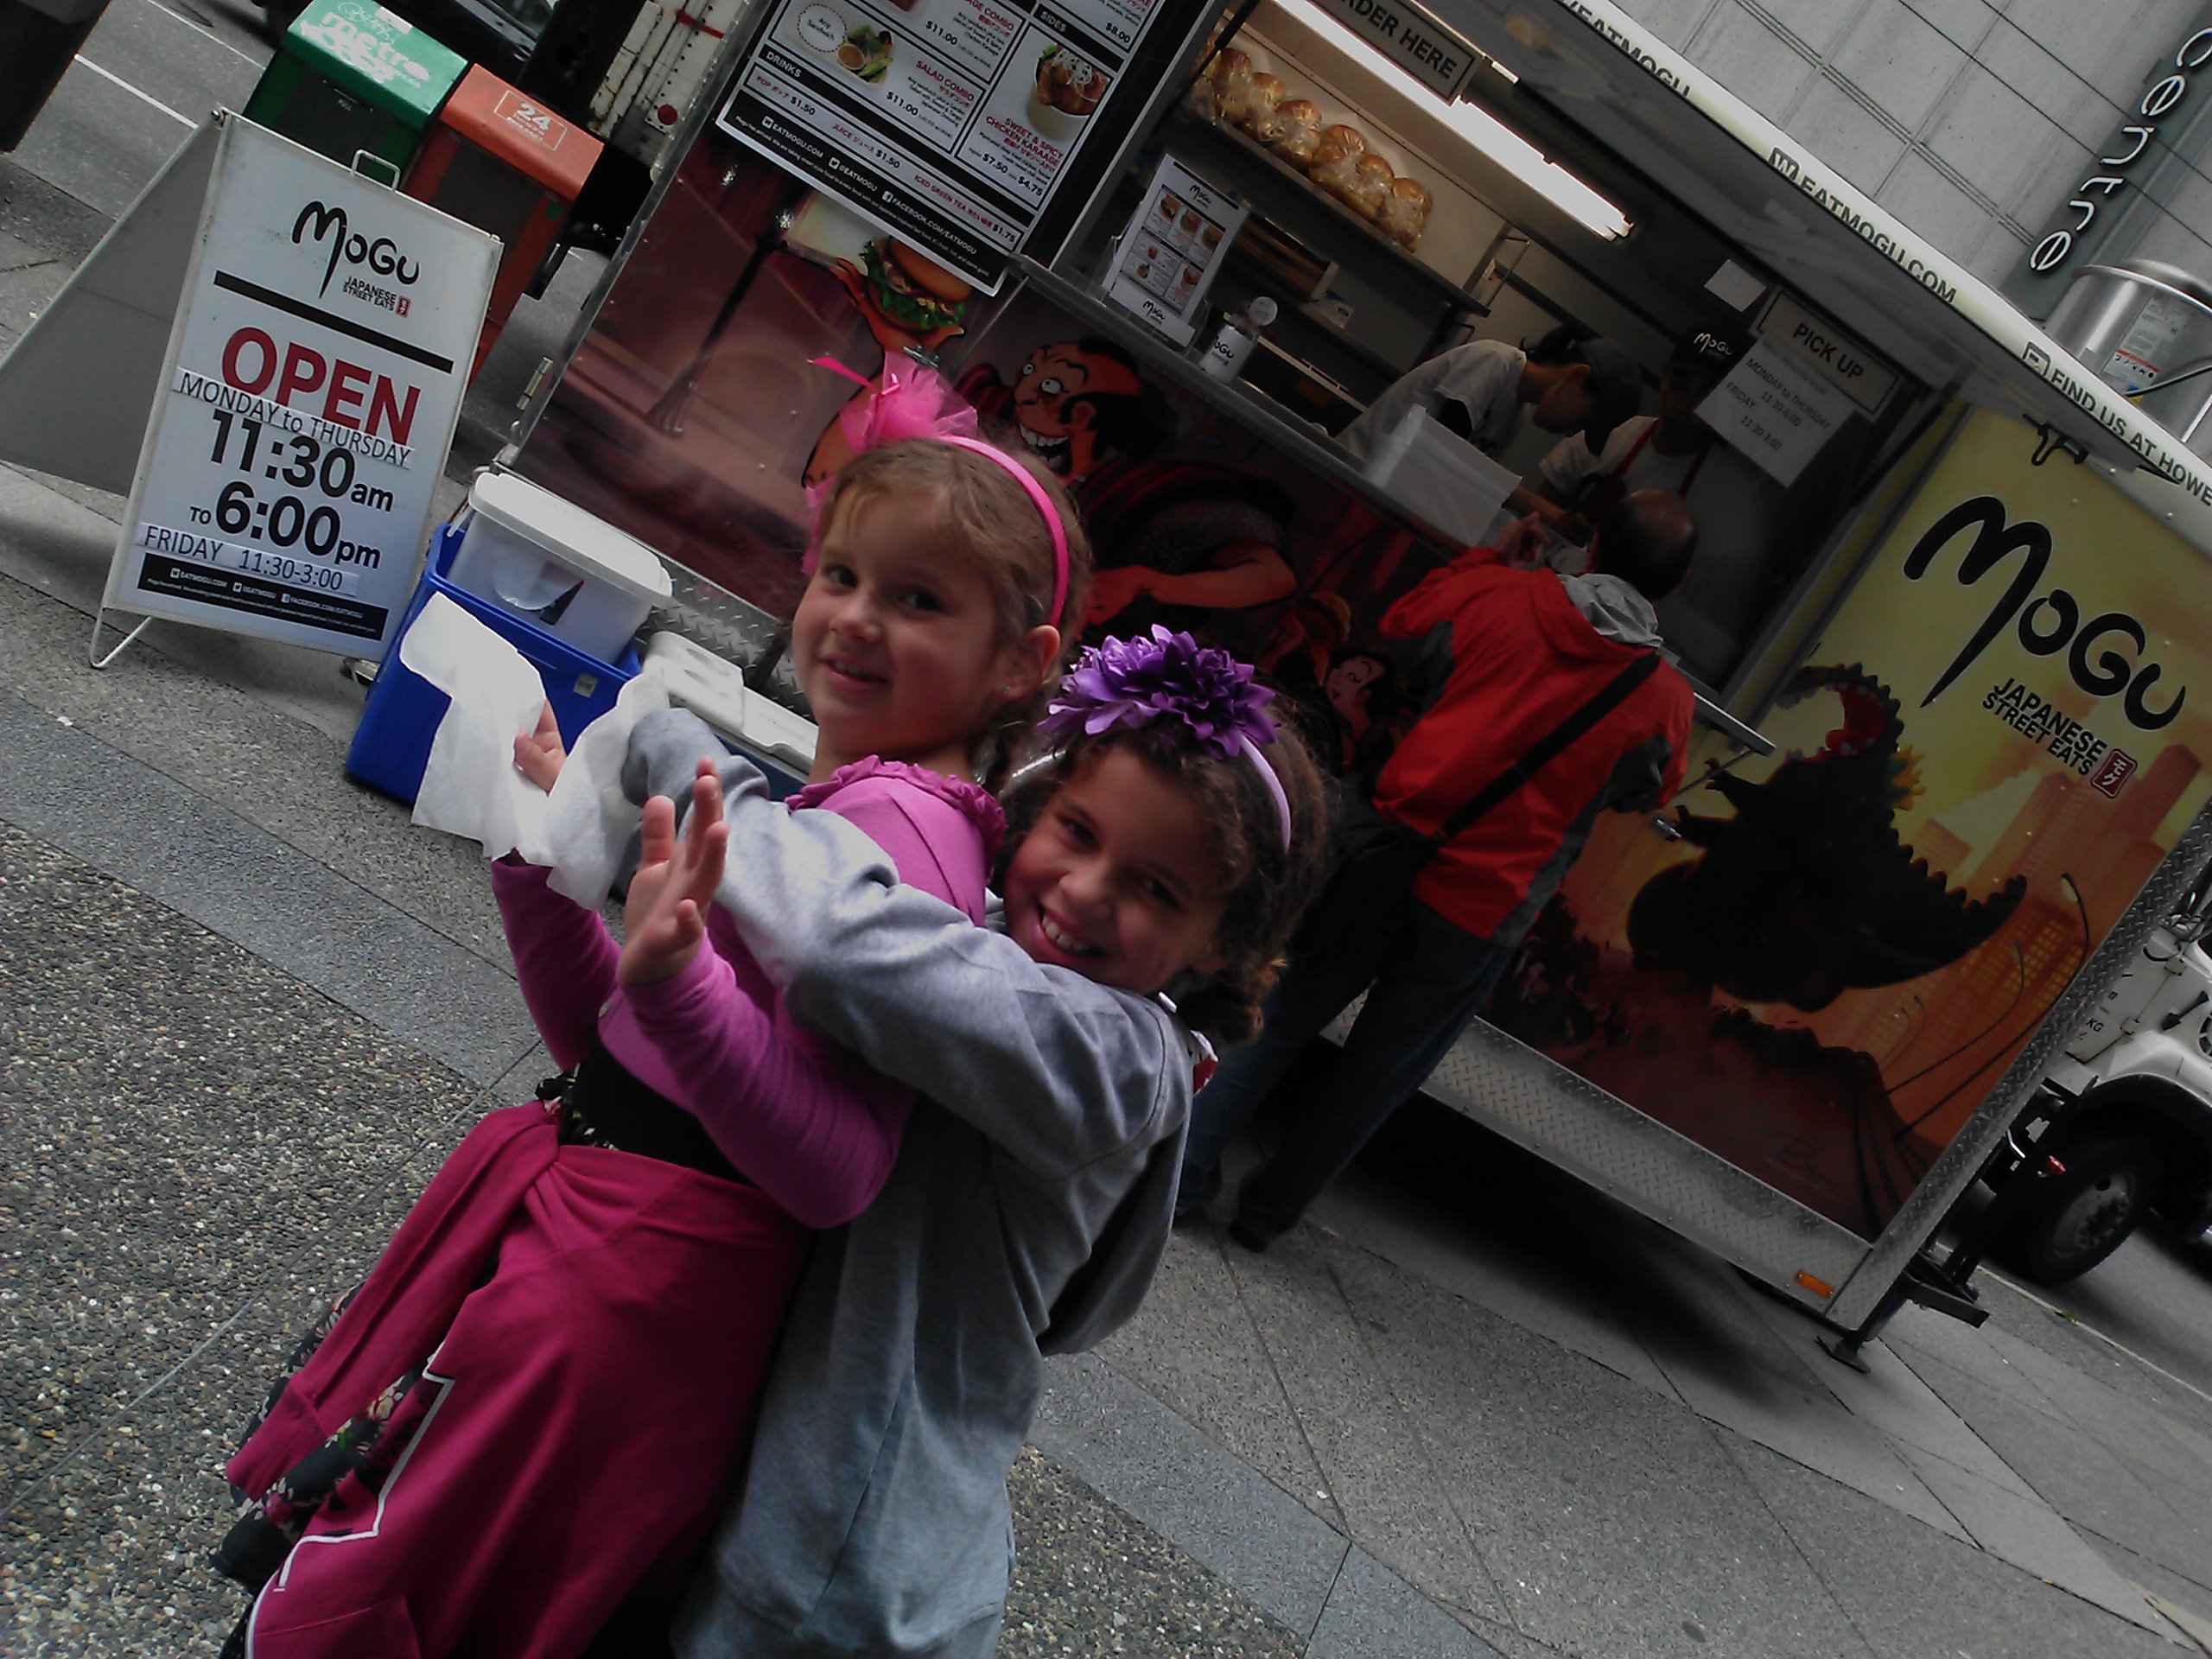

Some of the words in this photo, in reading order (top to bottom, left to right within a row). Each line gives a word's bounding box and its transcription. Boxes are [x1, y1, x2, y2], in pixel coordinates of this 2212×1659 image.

[925, 19, 958, 46] $11.00
[982, 7, 1014, 32] COMBO
[1039, 10, 1067, 32] SIDES
[1104, 22, 1131, 43] $8.00
[764, 49, 803, 79] DRINKS
[1398, 28, 1457, 79] HERE
[915, 60, 944, 82] SALAD
[947, 80, 975, 102] COMBO
[515, 100, 553, 132] 24
[885, 91, 919, 117] $11.00
[771, 122, 824, 160] EATMOGU.COM
[985, 115, 1021, 143] CHICKEN
[1020, 138, 1059, 167] KARAAGE
[1004, 118, 1032, 139] SWEET
[1039, 140, 1064, 160] SPICY
[789, 95, 817, 118] $1.50
[874, 148, 901, 170] $1.50
[912, 174, 931, 189] ICED
[951, 198, 968, 213] TEA
[990, 222, 1017, 245] $1.75
[982, 152, 1008, 174] $7.50
[1017, 175, 1043, 196] $4.75
[1799, 175, 1959, 303] EATMOGUCOM
[341, 284, 372, 302] STREET
[372, 296, 395, 312] EATS
[344, 275, 397, 303] JAPANESE
[1792, 322, 1837, 363] PICK
[1835, 353, 1866, 383] UP
[221, 326, 422, 448] OPEN
[1725, 380, 1757, 410] FRIDAY
[1745, 357, 1784, 392] MONDAY
[1789, 393, 1832, 431] THURSDAY
[179, 371, 279, 424] MONDAY
[281, 410, 304, 433] to
[307, 416, 411, 467] THURSDAY
[2050, 369, 2098, 413] FIND
[2129, 431, 2158, 458] AT
[2158, 450, 2212, 507] HOWE
[189, 505, 213, 526] TO
[144, 526, 225, 563] FRIDAY
[238, 550, 343, 592] 11:30-3:00
[1904, 495, 2187, 730] MOGU
[1982, 696, 2051, 748] STREET
[2048, 739, 2094, 777] EATS
[1993, 677, 2107, 762] JAPANESE
[2085, 1016, 2104, 1033] KG
